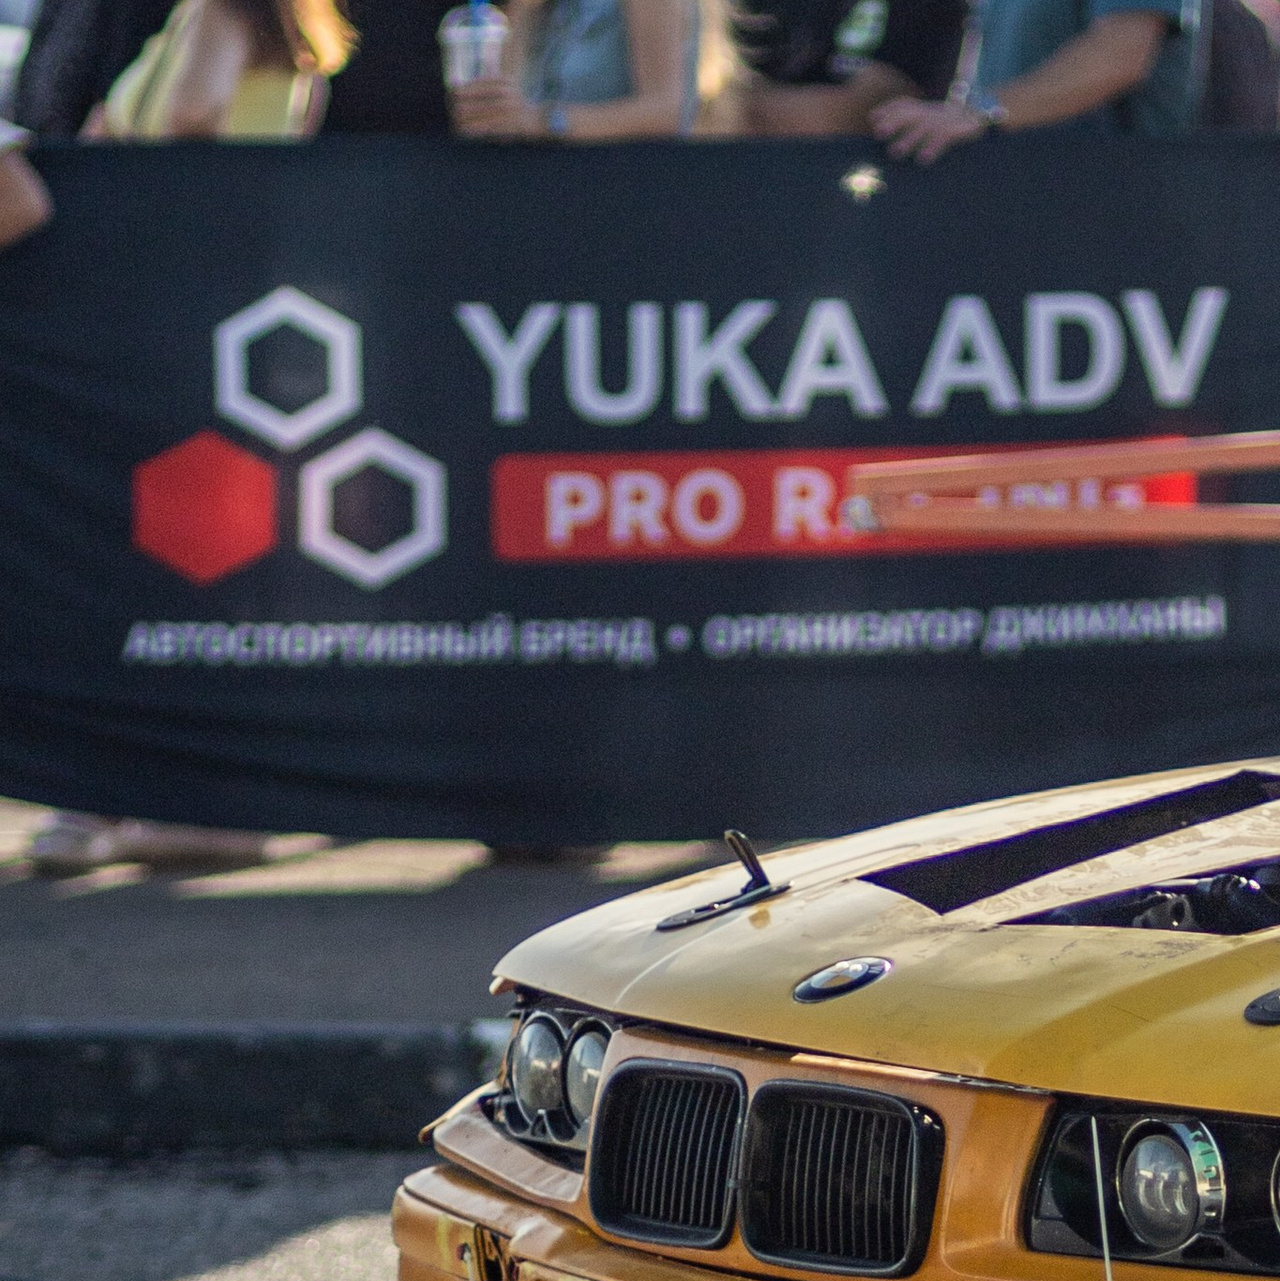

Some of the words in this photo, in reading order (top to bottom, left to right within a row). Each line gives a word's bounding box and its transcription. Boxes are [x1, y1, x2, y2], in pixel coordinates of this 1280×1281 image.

[457, 299, 888, 424] YUKA
[911, 286, 1228, 416] ADV
[542, 470, 745, 546] PRO
